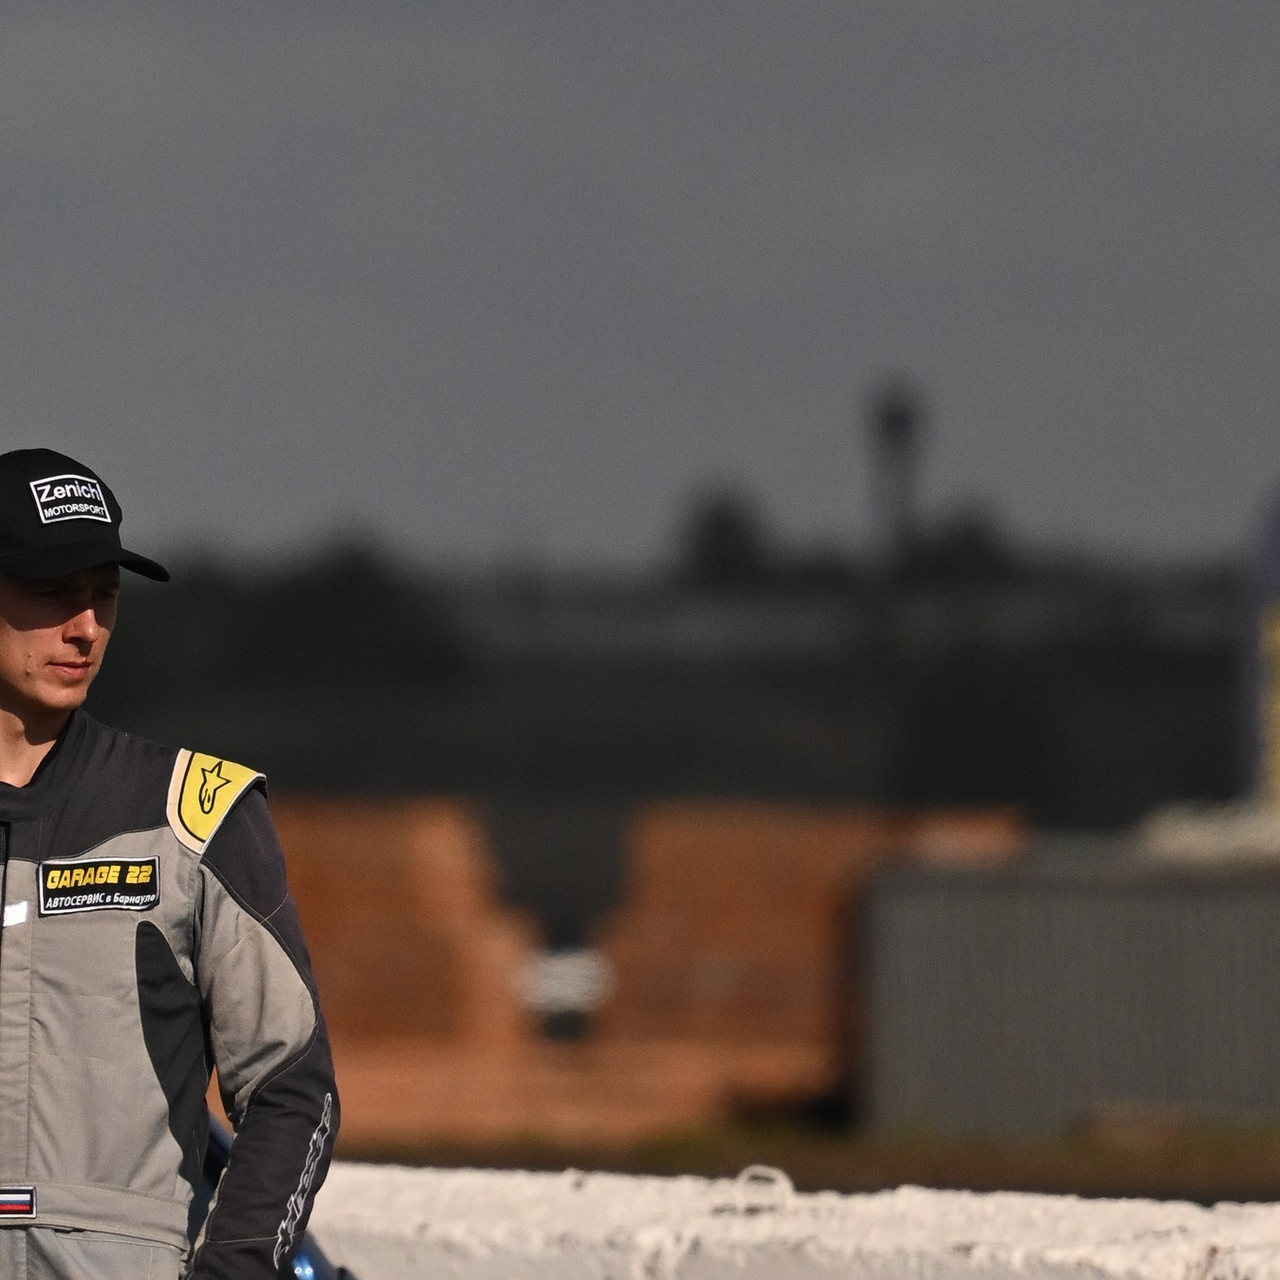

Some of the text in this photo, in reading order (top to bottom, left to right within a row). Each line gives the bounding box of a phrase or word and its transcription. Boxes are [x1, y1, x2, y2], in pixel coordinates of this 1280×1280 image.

[37, 480, 101, 502] Zenich
[43, 503, 105, 518] MOTORSPORT
[46, 865, 153, 889] GARAGE 22
[45, 892, 156, 909] АВТОСЕРВИС в Барнауле
